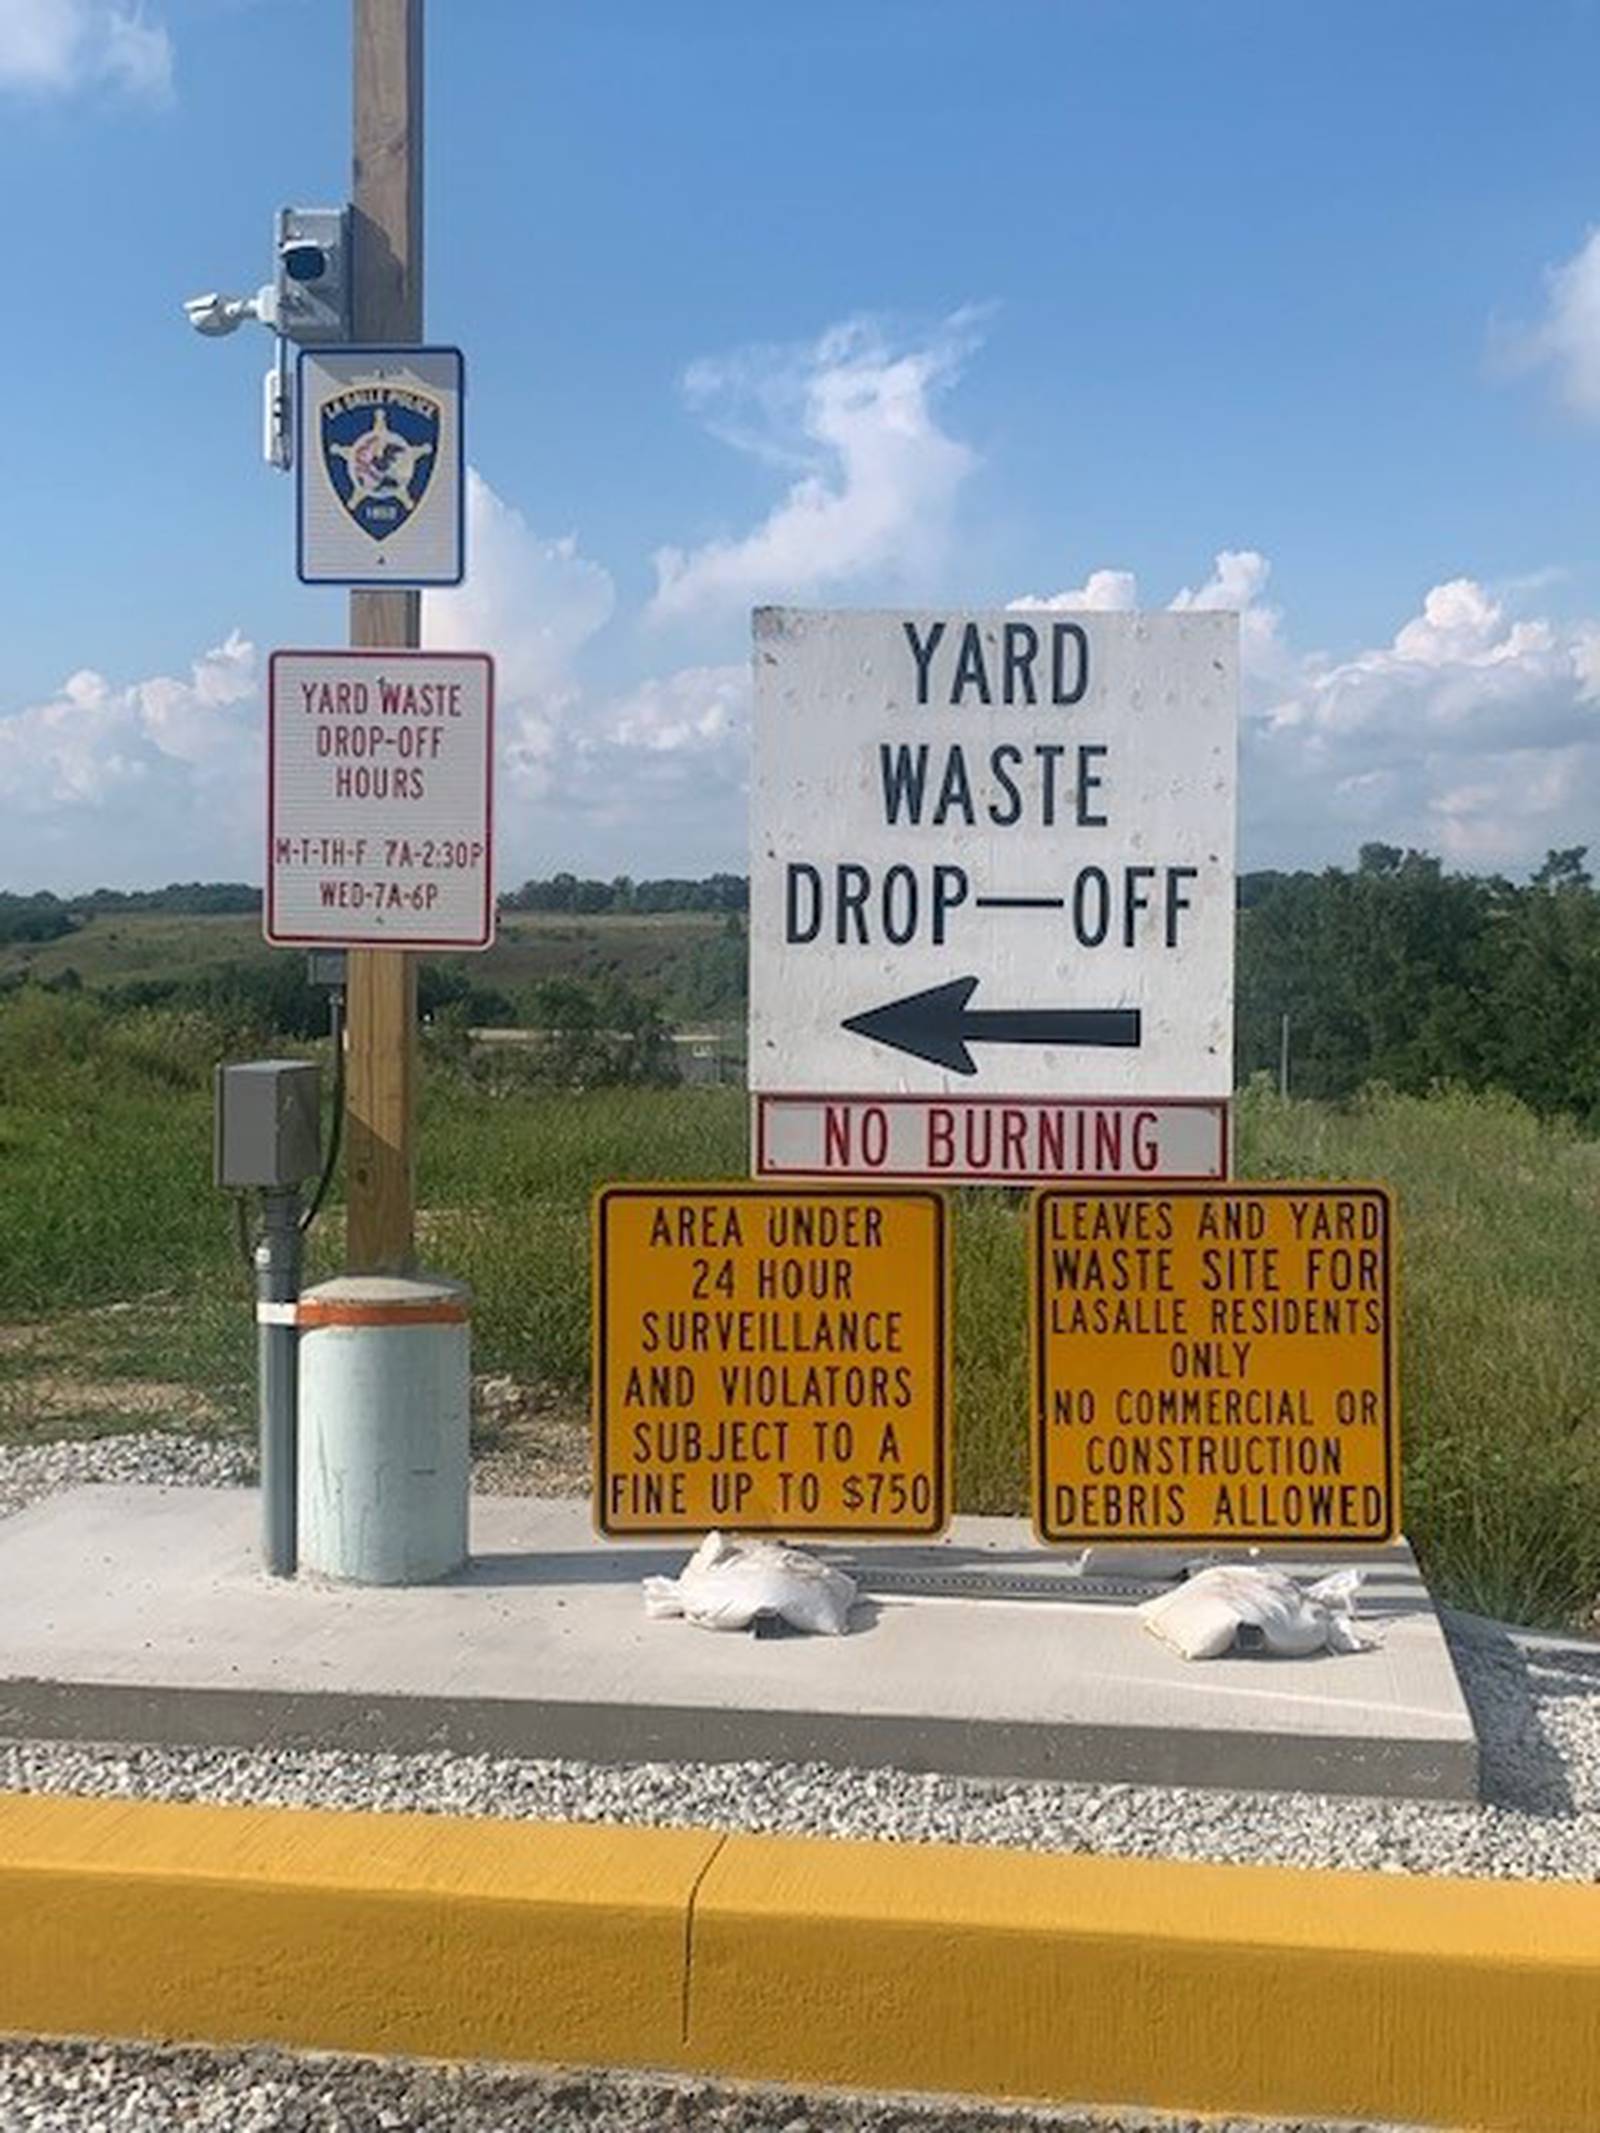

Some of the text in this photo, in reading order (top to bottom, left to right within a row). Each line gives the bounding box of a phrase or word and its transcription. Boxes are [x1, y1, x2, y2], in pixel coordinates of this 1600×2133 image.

[904, 622, 1090, 704] YARD
[301, 683, 462, 717] YARD WASTE
[317, 726, 445, 758] DROP-OFF
[336, 768, 424, 799] HOURS
[880, 744, 1108, 826] WASTE
[276, 838, 367, 864] M-T-TH-F
[320, 882, 438, 910] WED-7A-6P
[825, 1106, 1159, 1176] NO BURNING
[650, 1206, 883, 1247] AREA UNDER
[1052, 1202, 1380, 1241] LEAVES AND YARD
[692, 1259, 852, 1299] 24 HOUR
[1053, 1248, 1379, 1291] WASTE SITE FOR
[642, 1311, 903, 1353] SURVEILLANCE
[1052, 1299, 1382, 1335] LASALLE RESIDENTS
[1171, 1342, 1251, 1379] ONLY
[624, 1366, 912, 1408] AND VIOLATORS
[1055, 1389, 1378, 1427] NO COMMERCIAL OR
[633, 1422, 900, 1463] SUBJECT TO A
[1086, 1436, 1342, 1476] CONSTRUCTION
[612, 1473, 931, 1514] FINE UP TO $750
[1056, 1485, 1382, 1528] DEBRIS ALLOWED
